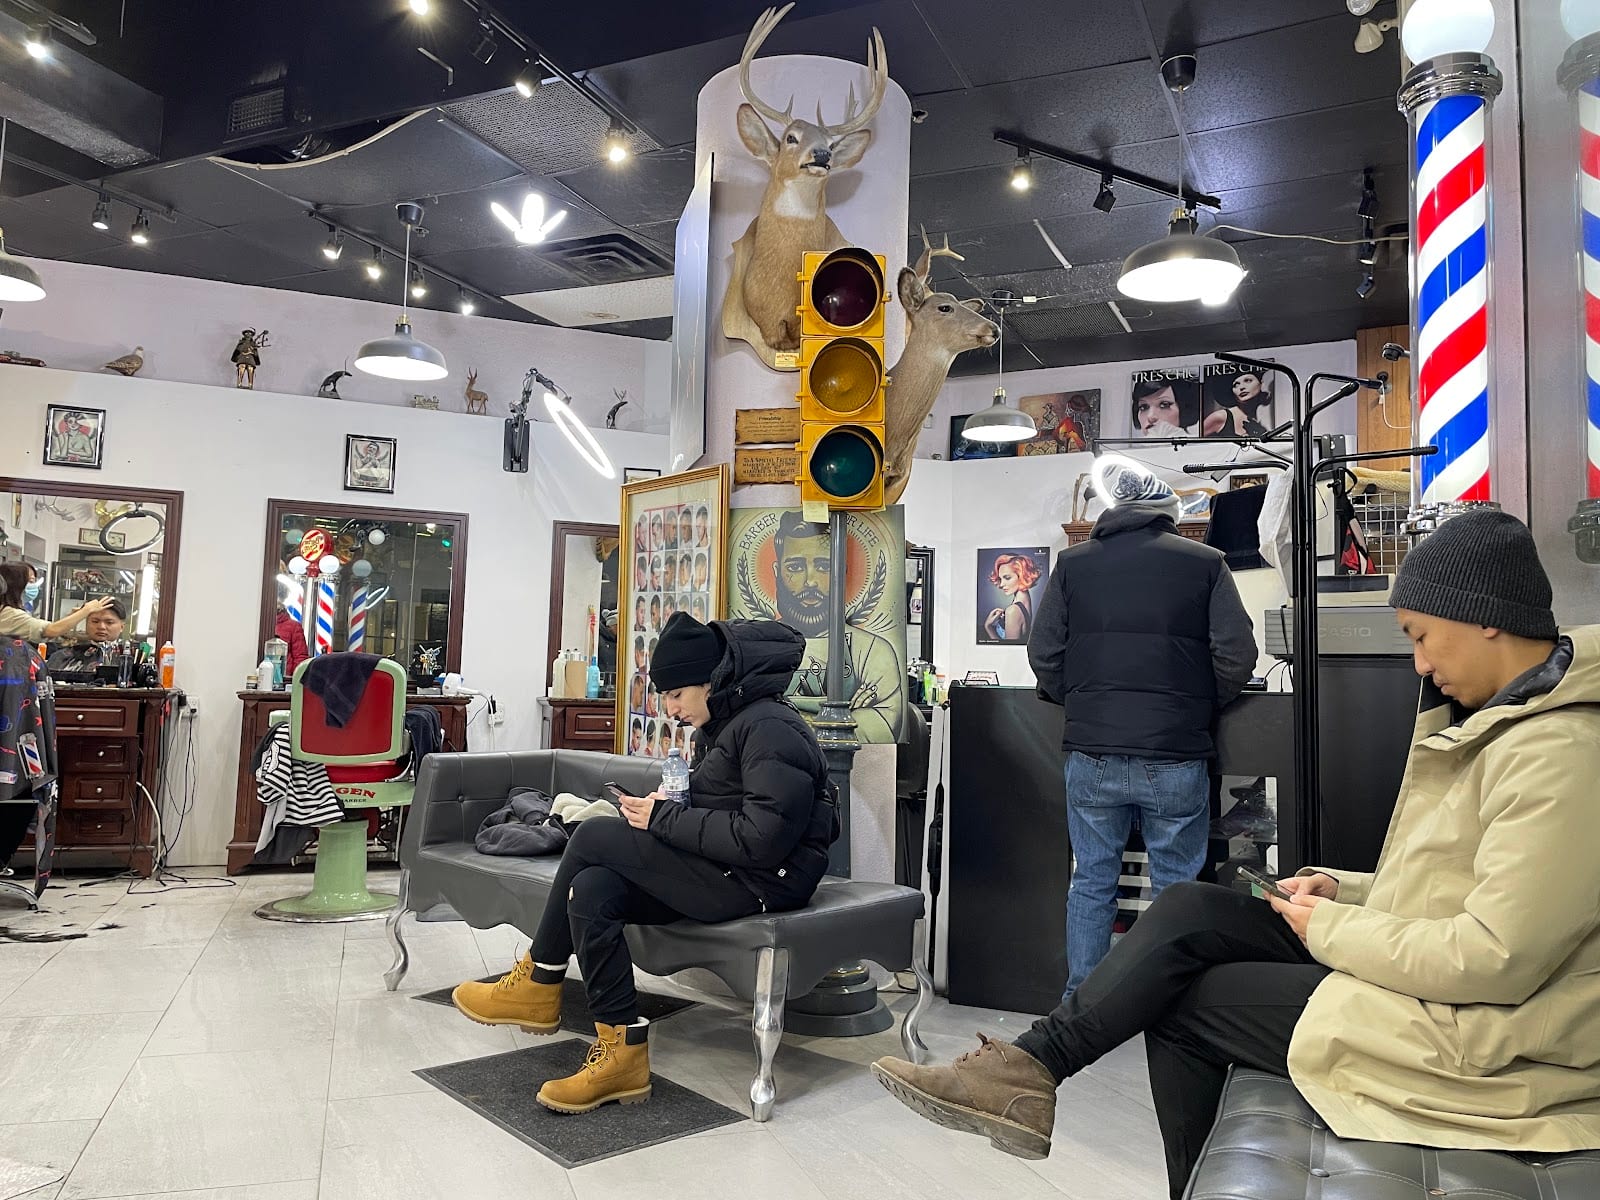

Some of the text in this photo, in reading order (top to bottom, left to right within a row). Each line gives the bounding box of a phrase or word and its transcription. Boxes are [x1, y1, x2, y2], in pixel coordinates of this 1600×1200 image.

[740, 512, 779, 550] BARBER
[857, 521, 880, 547] LIFE
[1319, 626, 1372, 638] CASIO
[335, 787, 376, 799] GEN
